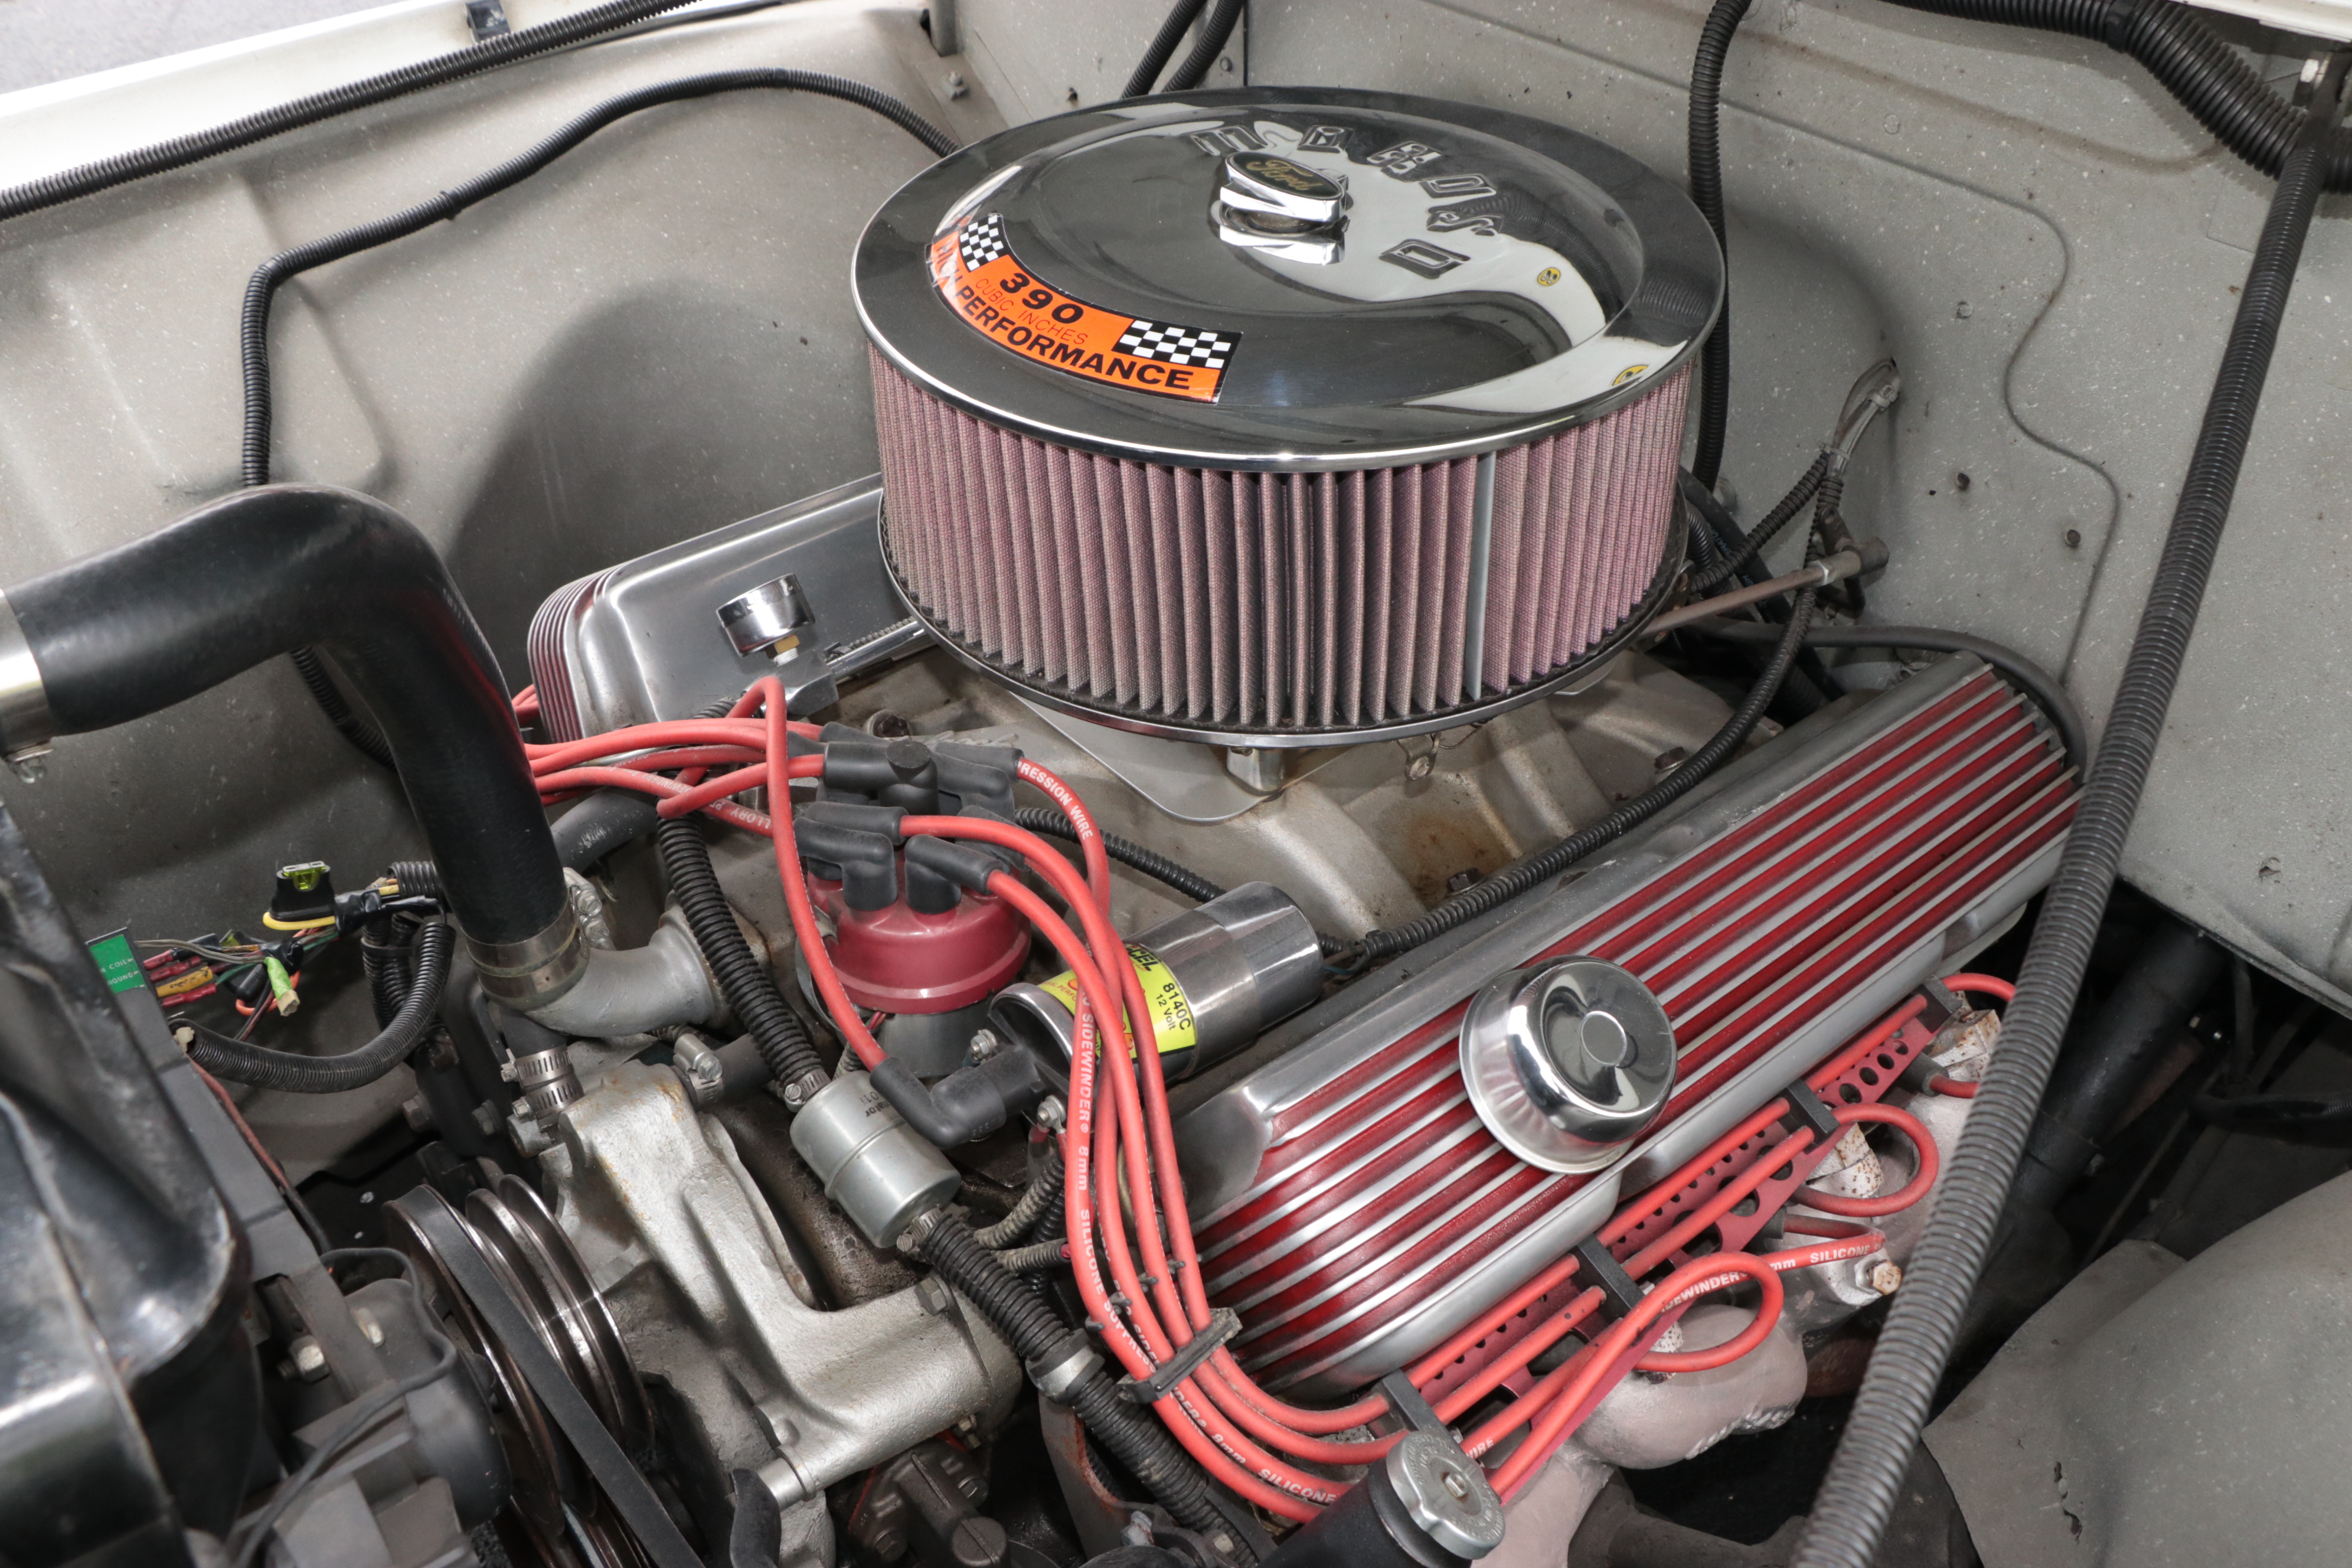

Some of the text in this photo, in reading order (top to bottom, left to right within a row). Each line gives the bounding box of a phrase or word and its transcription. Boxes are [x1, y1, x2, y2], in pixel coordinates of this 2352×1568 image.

[1246, 160, 1323, 190] Ford
[936, 240, 1195, 390] HIGH PERFORMANCE
[975, 277, 1088, 345] CUBIC INCHES
[999, 272, 1084, 325] 390
[730, 807, 771, 829] LLORY
[1018, 761, 1094, 840] RESSION WIRE
[107, 972, 134, 986] ROUND
[1156, 994, 1176, 1031] 12 Volt
[1163, 982, 1191, 1030] 8140C
[1078, 1145, 1089, 1191] 8mm
[1080, 1208, 1105, 1295] SILICONE
[1772, 1259, 1796, 1271] mm
[1809, 1244, 1871, 1264] SILICONE
[1211, 1433, 1246, 1464] 8mm
[1258, 1468, 1337, 1504] SILICONE
